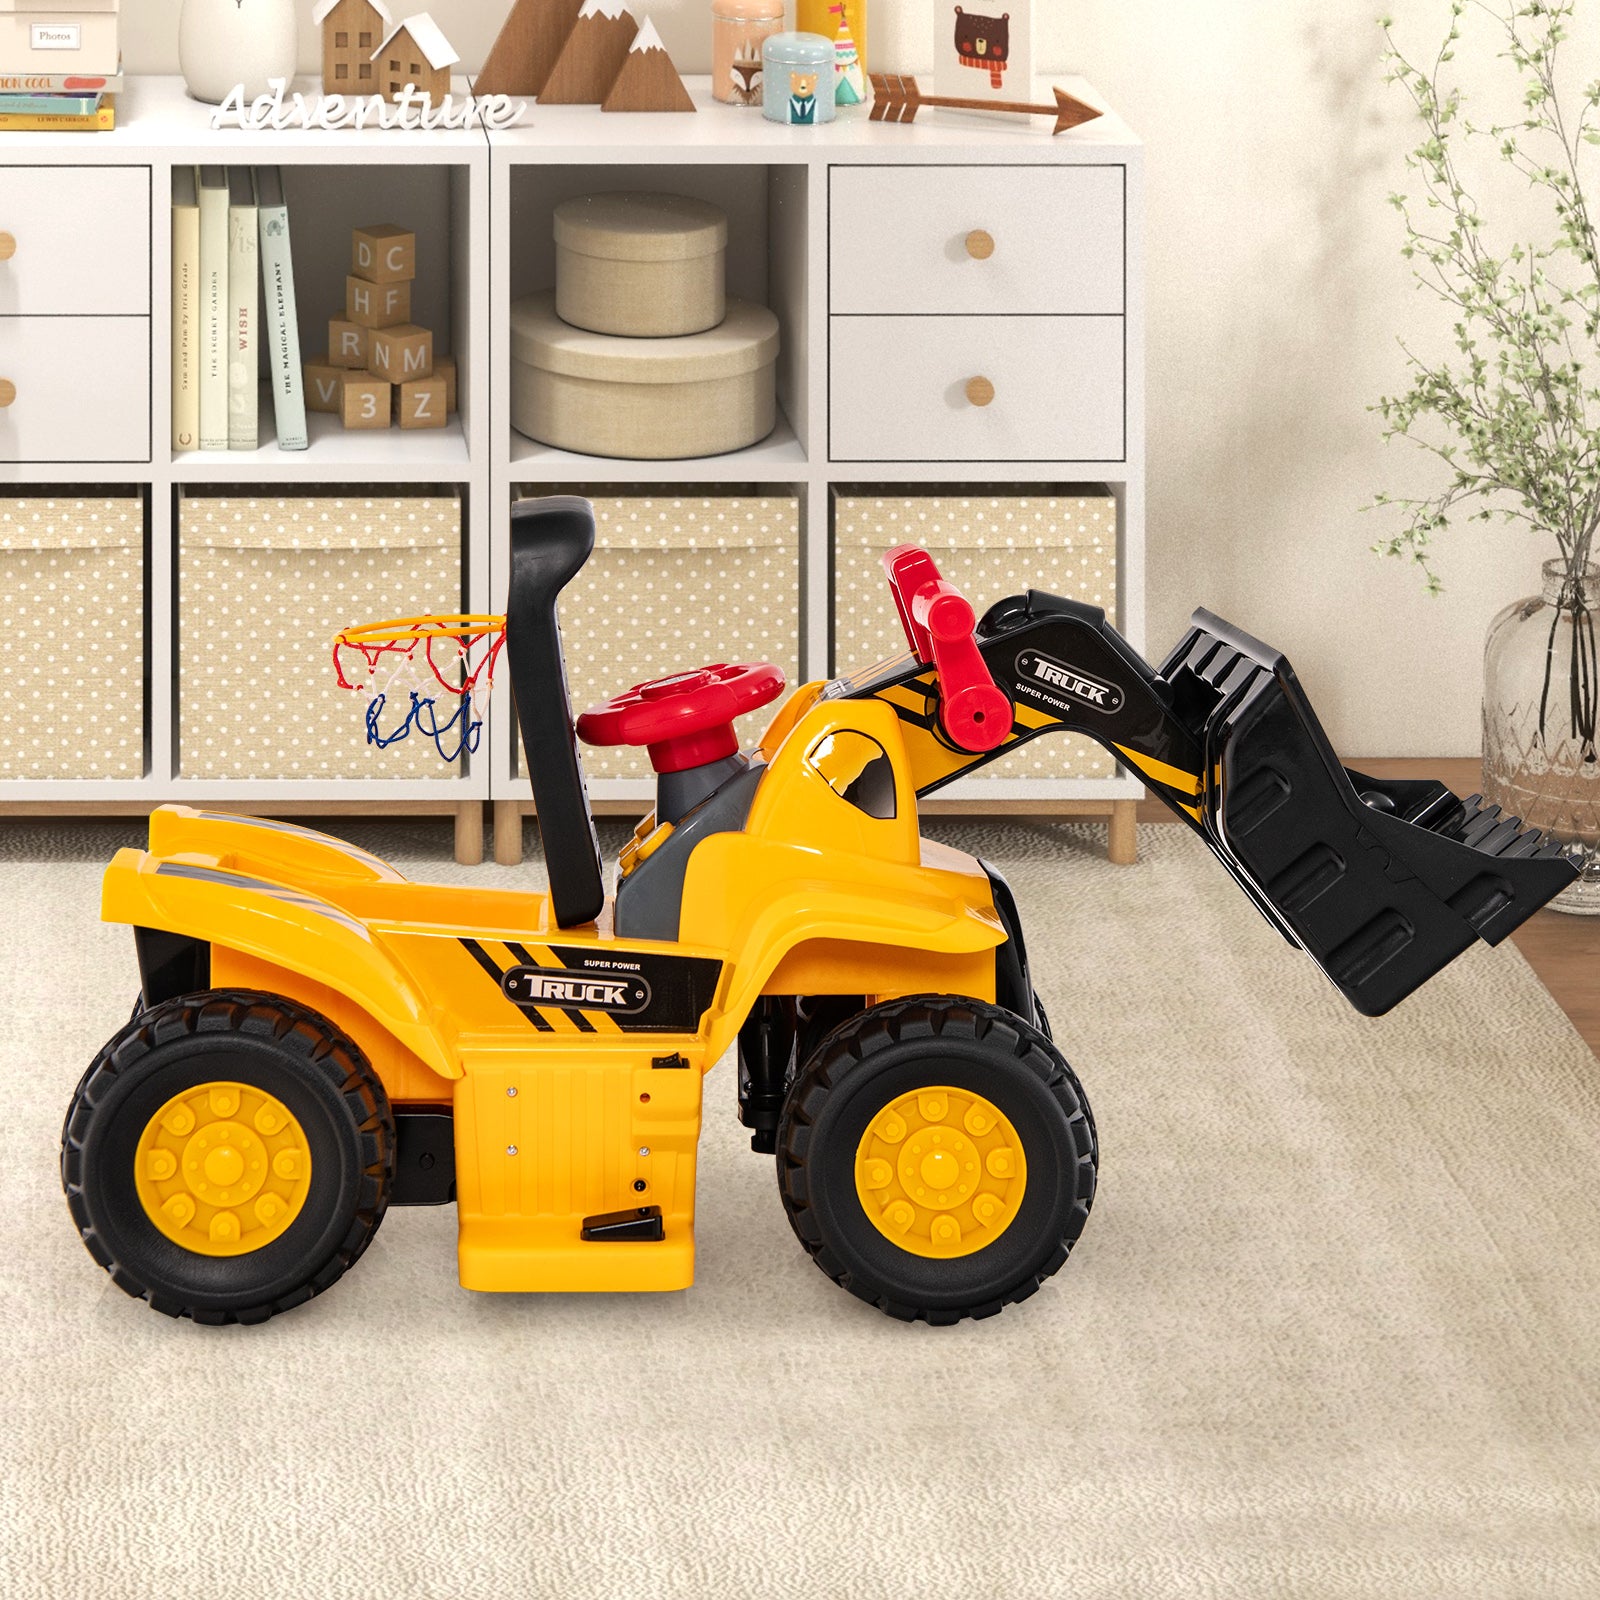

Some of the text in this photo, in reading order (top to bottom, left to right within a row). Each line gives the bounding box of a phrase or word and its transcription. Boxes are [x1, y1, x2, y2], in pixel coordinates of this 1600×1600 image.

[39, 31, 71, 41] Photos
[25, 77, 54, 89] COOL
[209, 77, 527, 130] Adventure
[358, 242, 371, 267] D
[386, 246, 404, 271] C
[354, 287, 370, 315] H
[386, 290, 398, 315] F
[239, 307, 248, 351] WISH
[274, 262, 292, 395] THE MAGICAL ELEPHANT
[341, 332, 360, 356] R
[375, 342, 390, 370] N
[403, 345, 425, 373] M
[315, 378, 336, 403] V
[360, 393, 377, 419] 3
[414, 393, 431, 418] Z
[1033, 657, 1110, 706] TRUCK
[1015, 682, 1071, 711] SUPER POWER
[583, 959, 641, 971] SUPER POWER
[523, 974, 629, 1005] TRUCK
